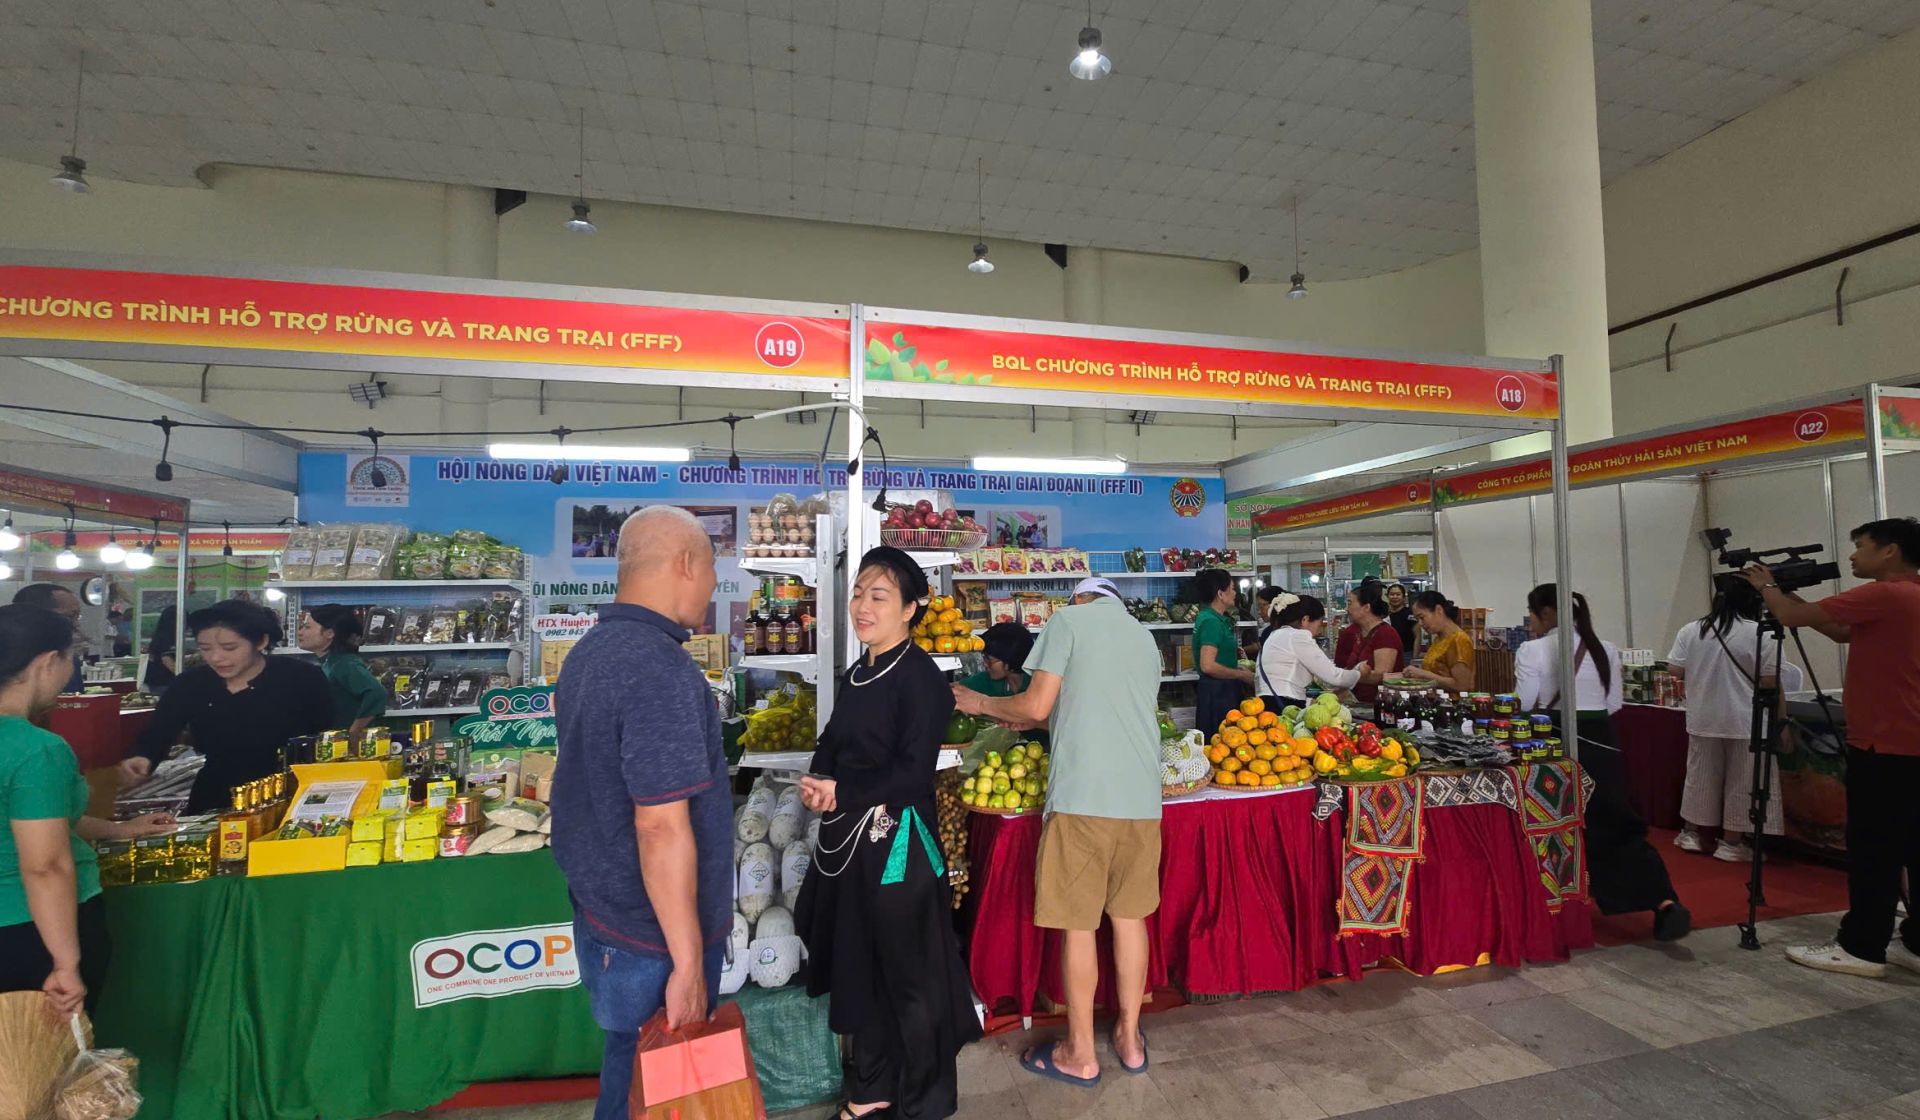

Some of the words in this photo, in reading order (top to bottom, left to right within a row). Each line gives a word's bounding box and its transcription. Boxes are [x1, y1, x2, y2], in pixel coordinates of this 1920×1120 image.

[121, 300, 209, 324] TRÌNH
[220, 300, 261, 327] HỖ
[270, 310, 329, 336] TRỢ
[336, 312, 414, 337] RỪNG
[421, 316, 456, 339] VÀ
[462, 322, 550, 344] TRANG
[557, 328, 614, 351] TRẠI
[620, 332, 683, 352] (FFF)
[764, 338, 798, 357] A19
[992, 354, 1031, 372] BQL
[1036, 357, 1116, 377] CHƯƠNG
[1119, 360, 1172, 380] TRÌNH
[1177, 361, 1202, 382] HỖ
[1206, 369, 1240, 388] TRỢ
[1244, 369, 1292, 389] RỪNG
[1295, 372, 1316, 390] VÀ
[1320, 377, 1372, 394] TRANG
[1377, 381, 1411, 398] TRẠI
[1414, 384, 1452, 400] (FFF)
[1501, 388, 1522, 403] A18
[1800, 422, 1824, 436] A22
[1477, 478, 1500, 490] CÔNG
[1502, 476, 1512, 485] TY
[1604, 454, 1632, 468] THỦY
[1634, 447, 1656, 463] HẢI
[1658, 443, 1682, 459] SẢN
[1685, 438, 1713, 456] VIỆT
[1717, 434, 1748, 448] NAM
[438, 459, 470, 484] HỘI
[475, 460, 528, 481] NÔNG
[575, 462, 612, 485] VIỆT
[616, 465, 656, 483] NAM
[679, 464, 746, 484] CHƯƠNG
[750, 463, 798, 485] TRÌNH
[828, 470, 849, 486] TR
[908, 468, 926, 488] VÀ
[930, 472, 976, 490] TRANG
[980, 474, 1012, 494] TRẠI
[1015, 476, 1043, 492] GIAI
[1046, 477, 1083, 496] ĐOẠN
[1088, 478, 1096, 492] II
[1100, 478, 1126, 495] (FFF
[1129, 478, 1144, 497] II)
[550, 581, 588, 596] NÔNG
[538, 618, 557, 628] HTX
[424, 934, 572, 980] OCOP
[427, 984, 443, 994] ONE
[444, 978, 482, 990] COMMUNE
[498, 972, 533, 984] PRODUCT
[546, 969, 575, 978] VIETNAM
